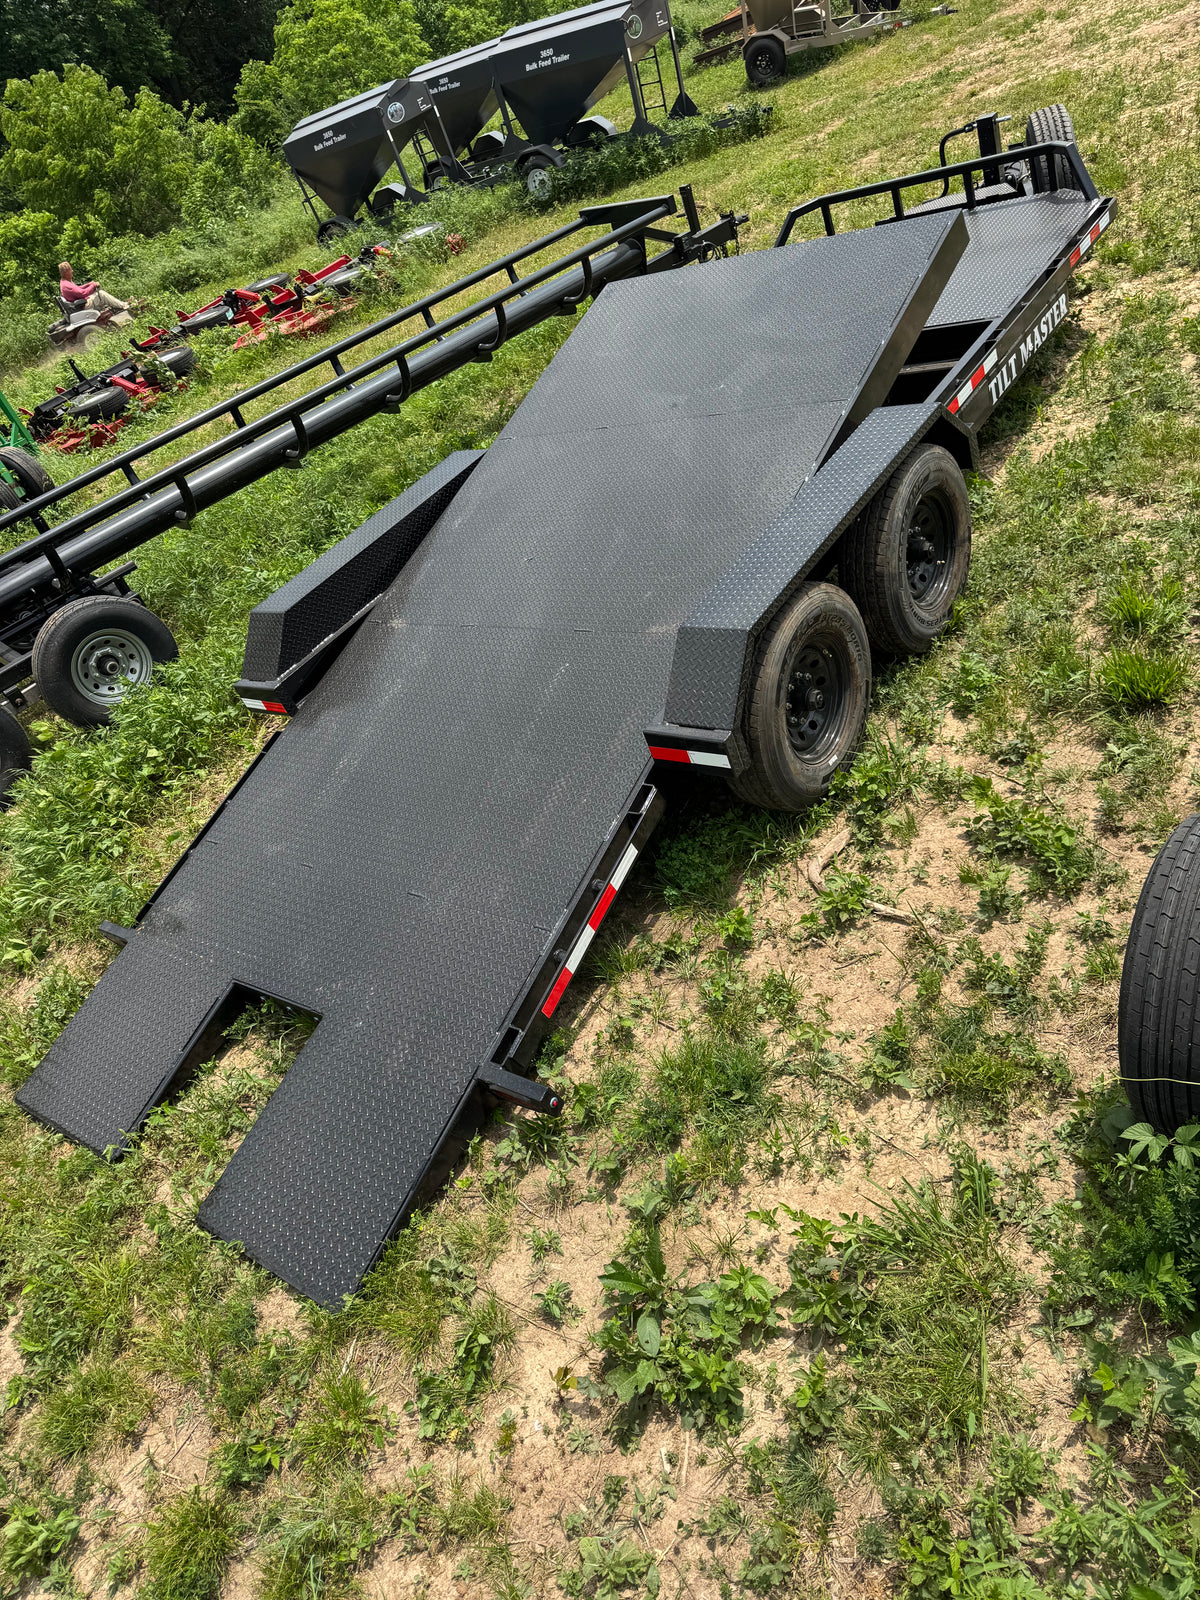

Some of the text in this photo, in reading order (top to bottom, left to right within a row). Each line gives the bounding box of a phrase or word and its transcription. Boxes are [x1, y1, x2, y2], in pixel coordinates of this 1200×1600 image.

[540, 48, 553, 58] 3650
[526, 54, 570, 71] Bulk Feed Trailer
[438, 84, 448, 92] Feed
[323, 138, 333, 147] Feed
[333, 134, 346, 143] Trailer
[988, 294, 1068, 405] TILT MASTER
